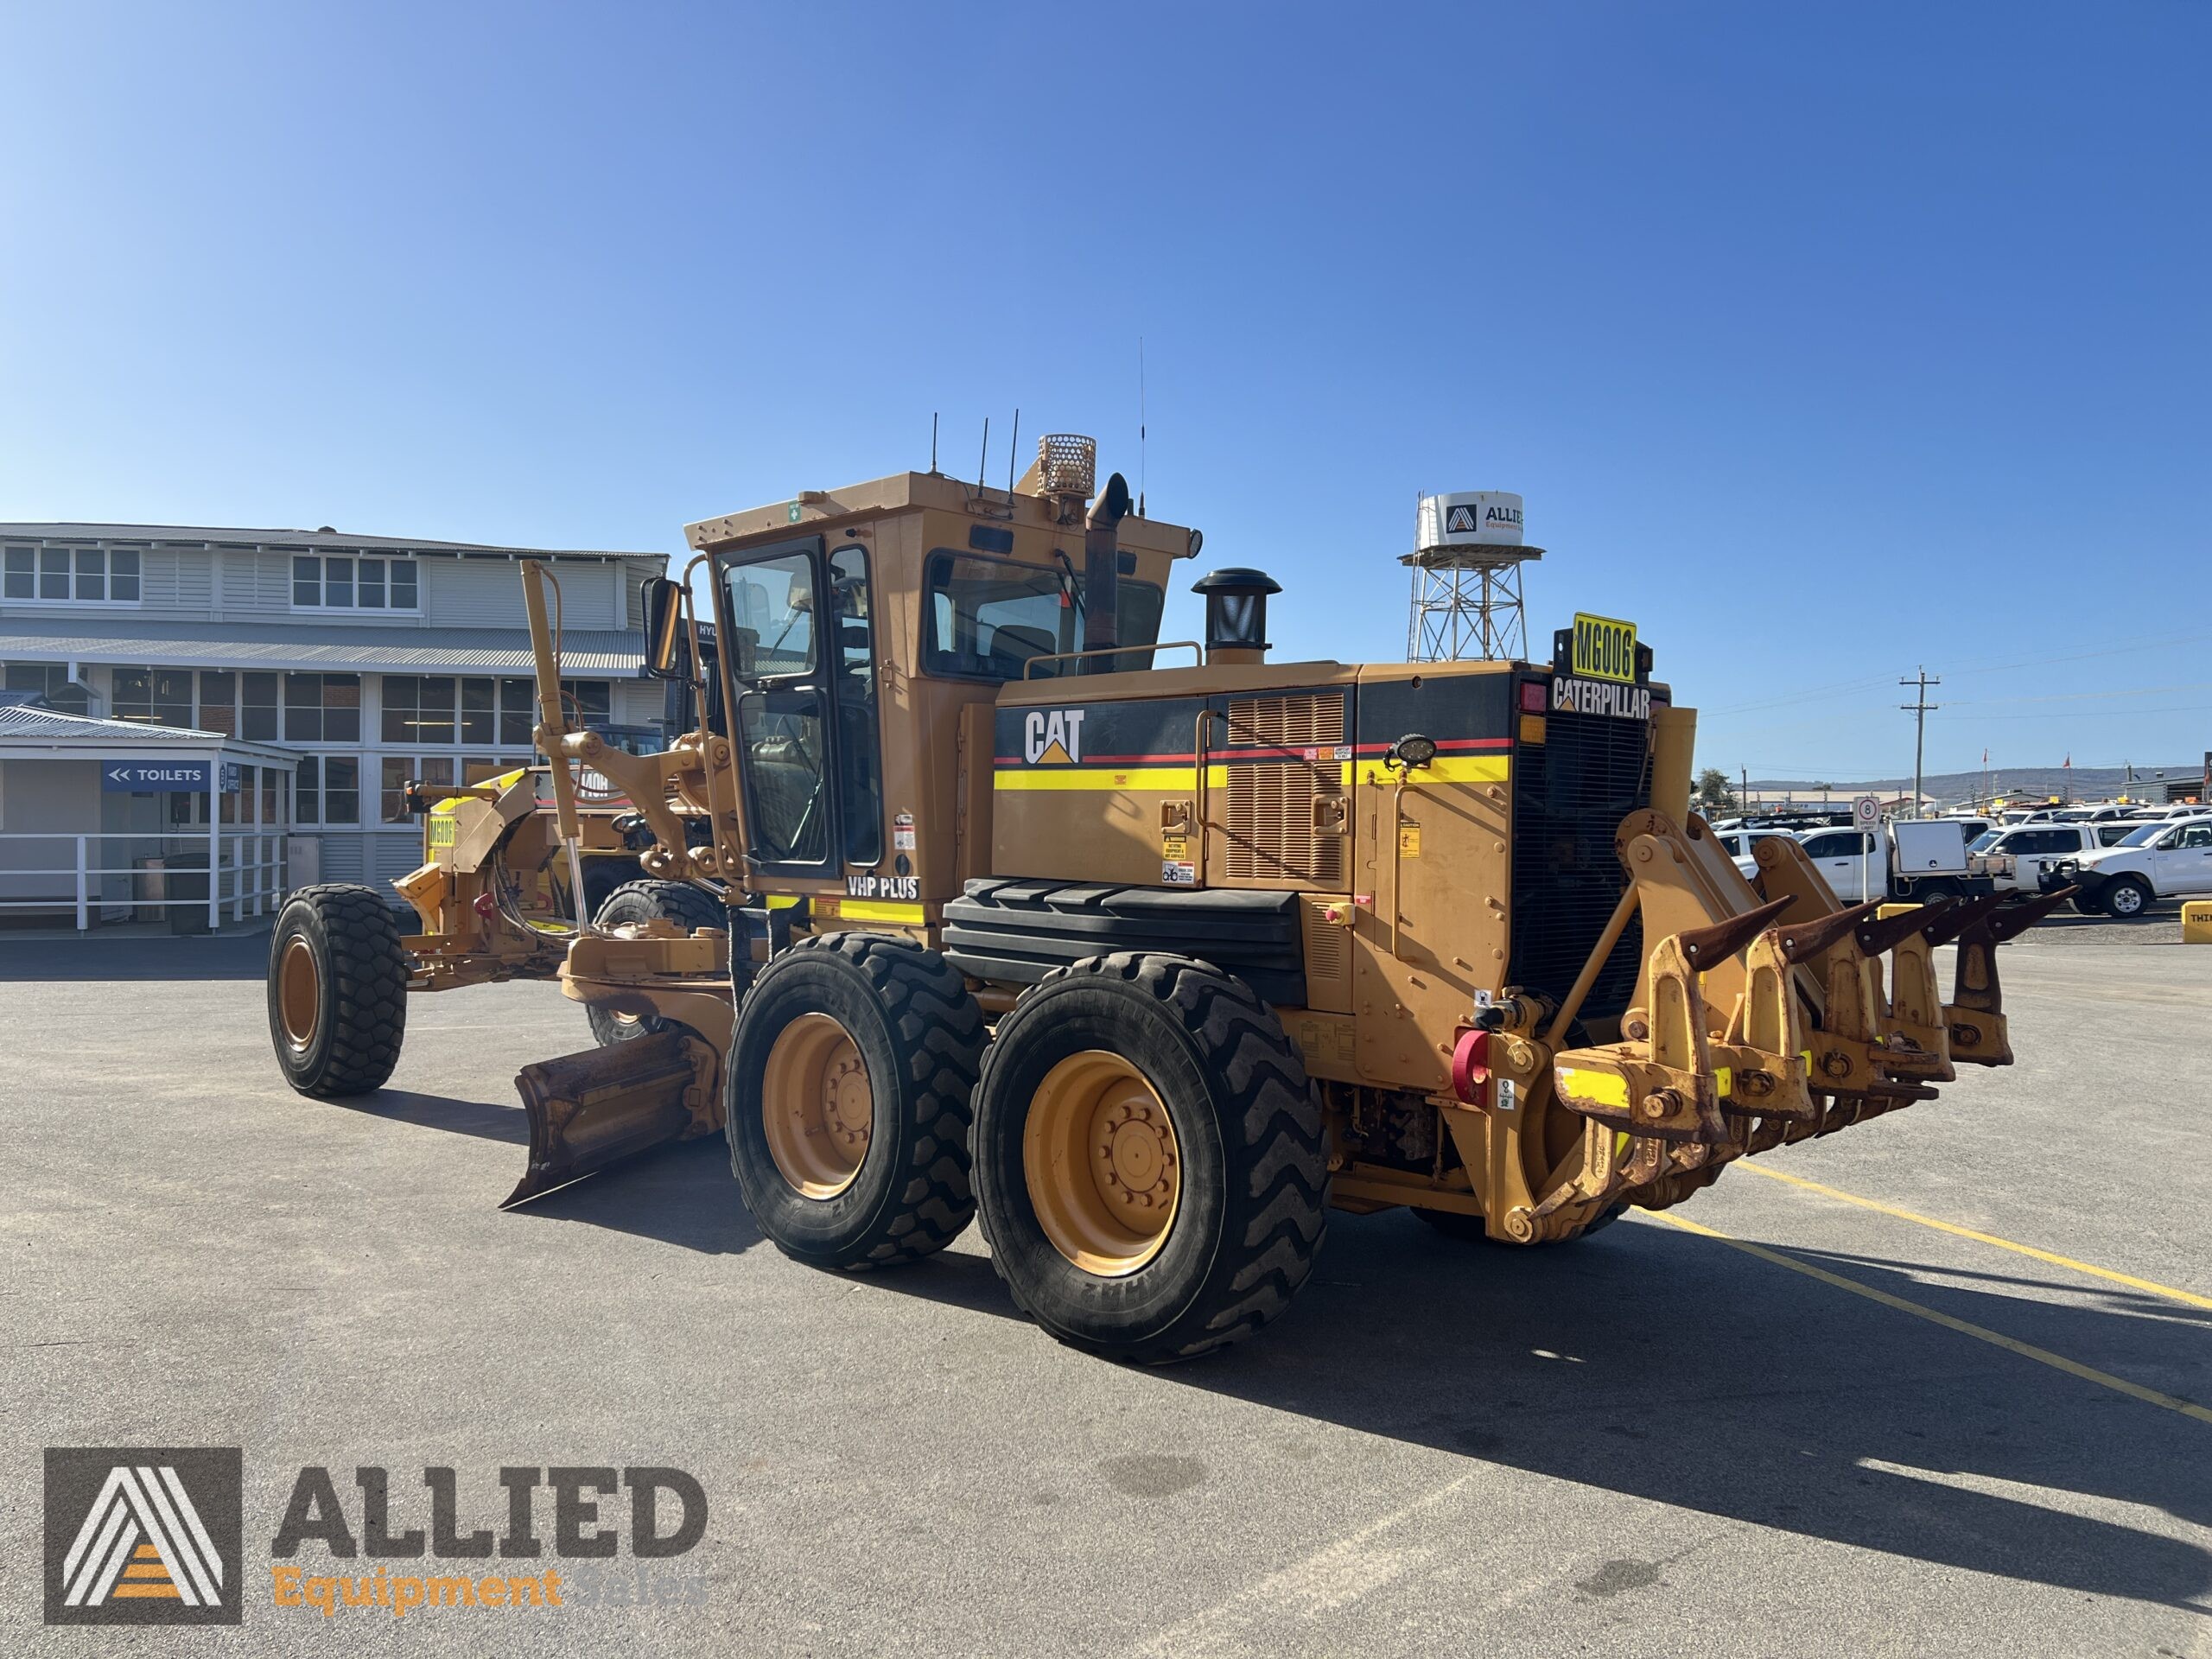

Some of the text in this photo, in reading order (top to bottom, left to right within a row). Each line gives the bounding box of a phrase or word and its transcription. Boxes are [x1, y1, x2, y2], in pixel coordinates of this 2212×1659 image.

[1485, 506, 1523, 524] ALLIE
[1576, 620, 1632, 677] MG006
[1553, 677, 1650, 720] CATERPILLAR
[1025, 709, 1084, 764] CAT
[137, 769, 201, 781] TOILETS
[1865, 804, 1871, 815] 8
[848, 876, 917, 899] VHP PLUS
